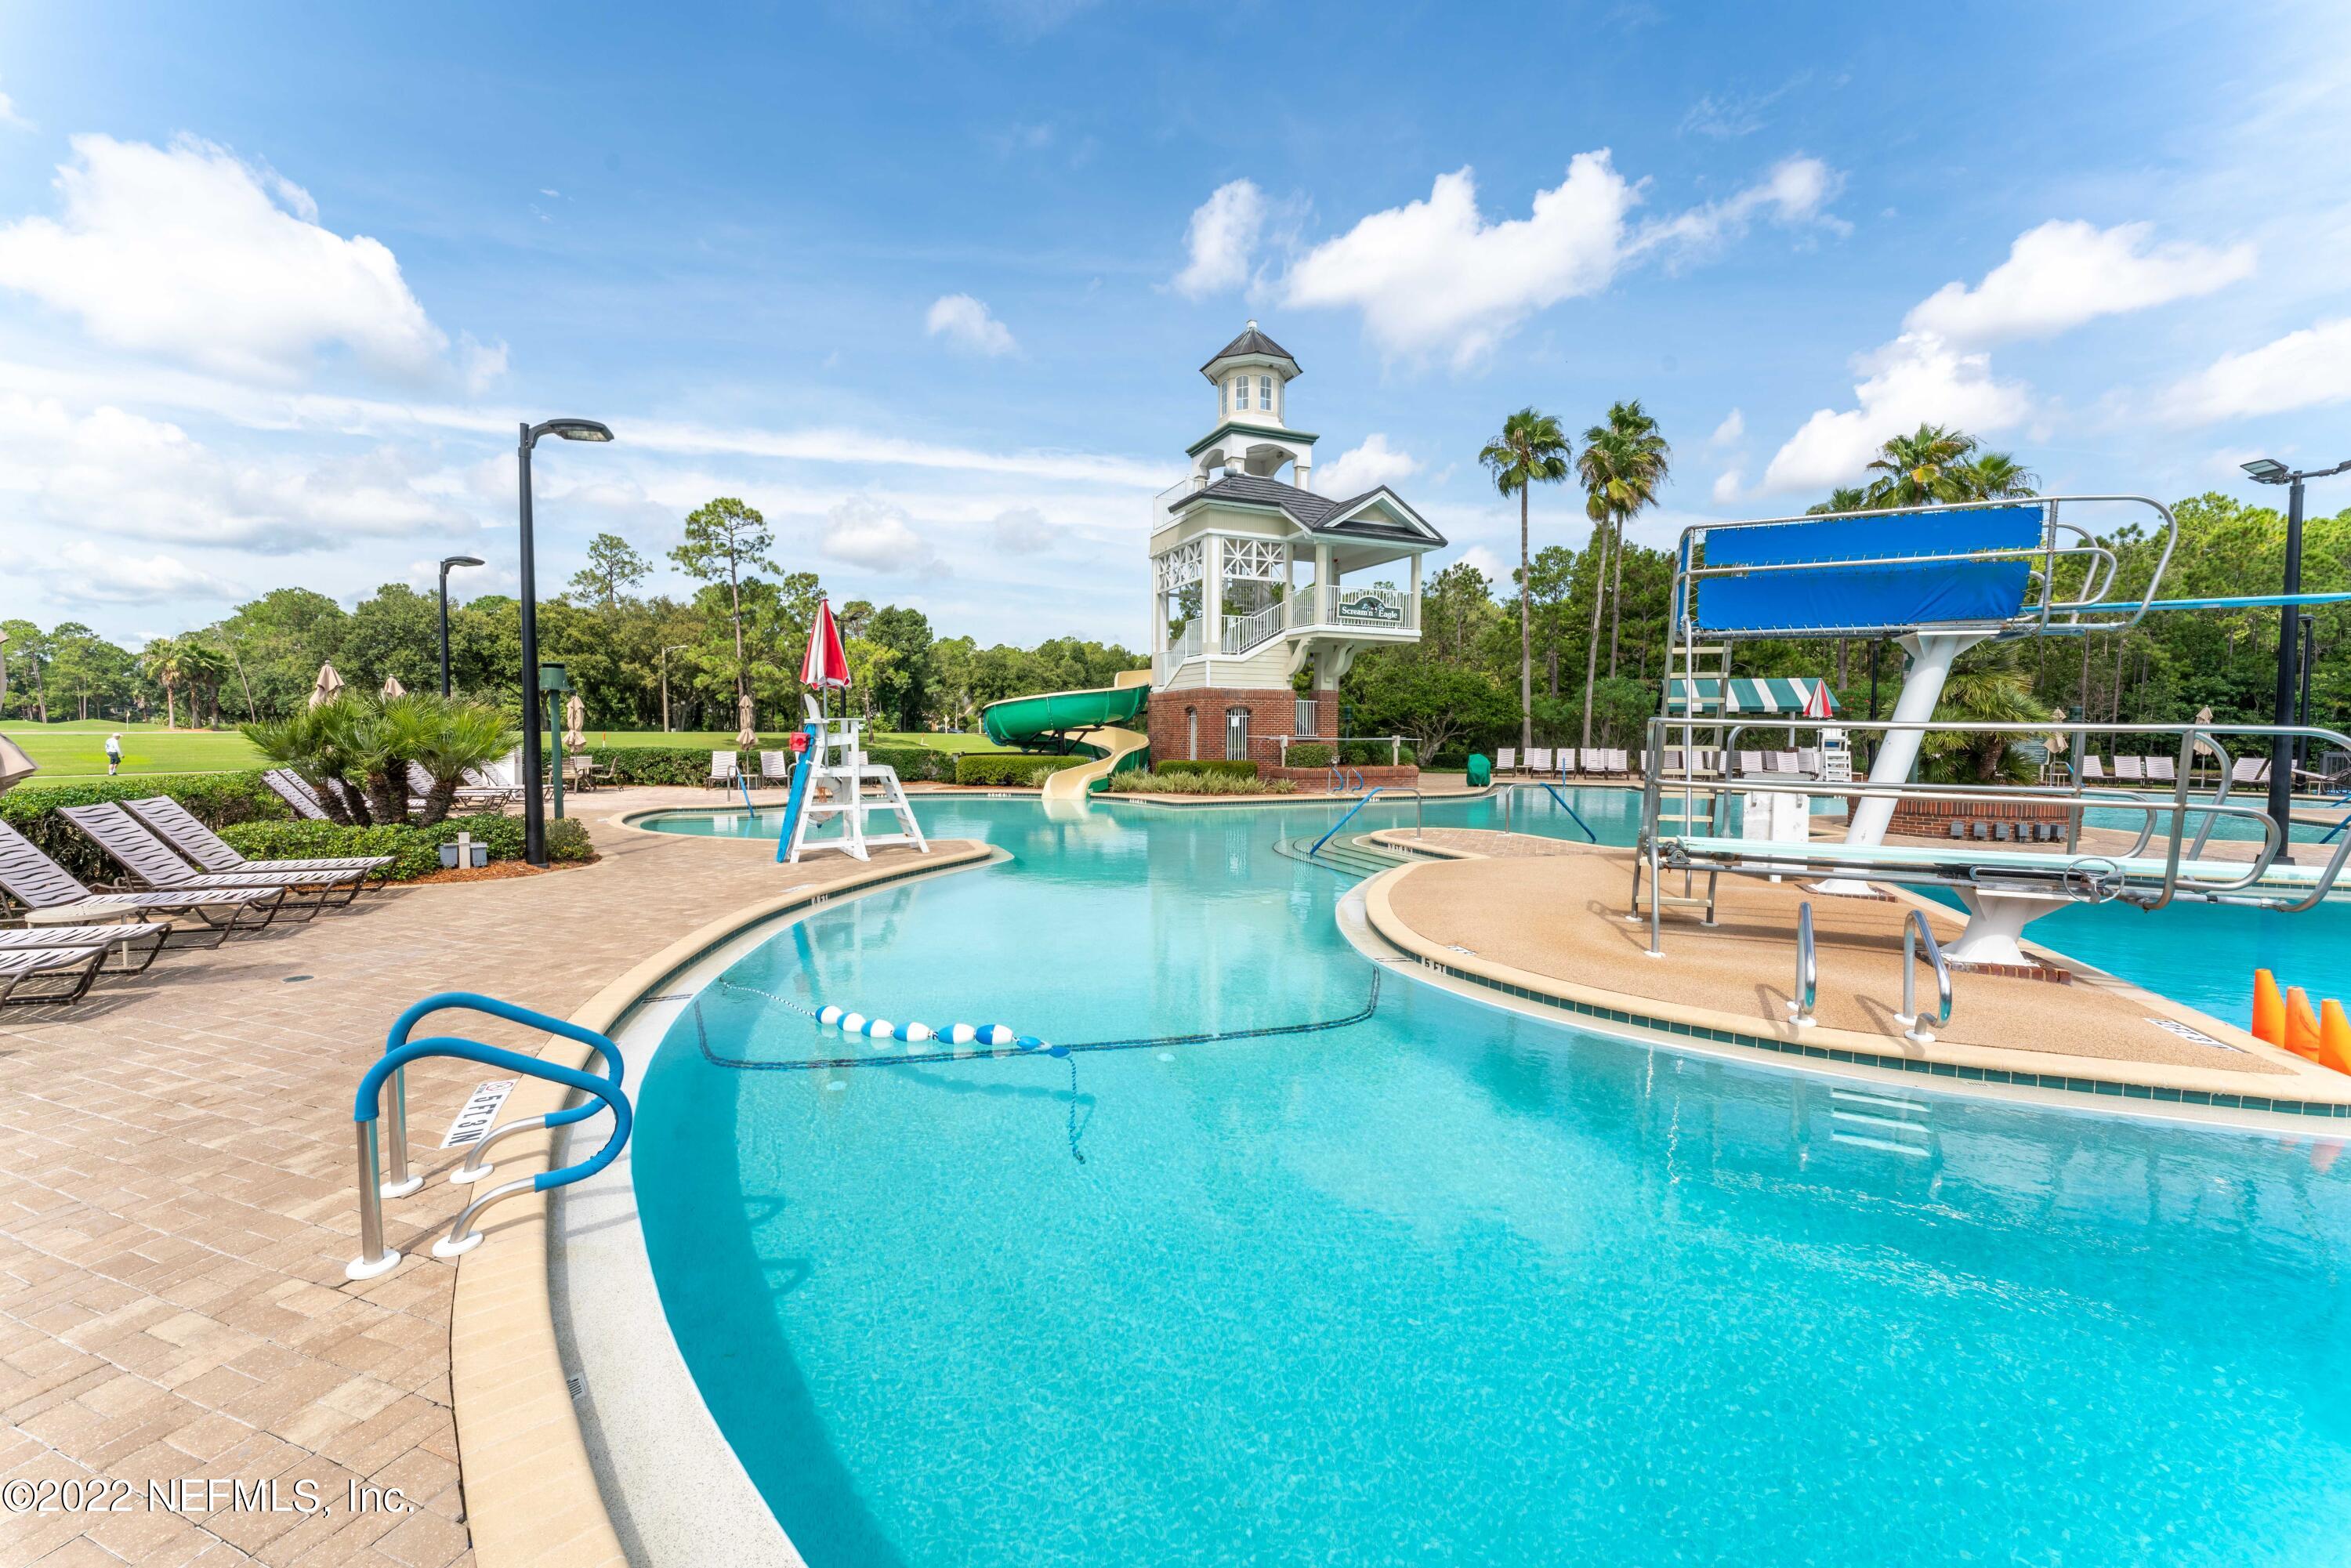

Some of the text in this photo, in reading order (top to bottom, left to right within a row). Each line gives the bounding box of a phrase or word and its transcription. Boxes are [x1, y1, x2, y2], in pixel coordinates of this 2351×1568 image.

[1342, 606, 1397, 619] Scream'n Eagle
[820, 893, 827, 903] FT
[1425, 958, 1445, 973] 5 FT
[458, 1119, 487, 1128] 3
